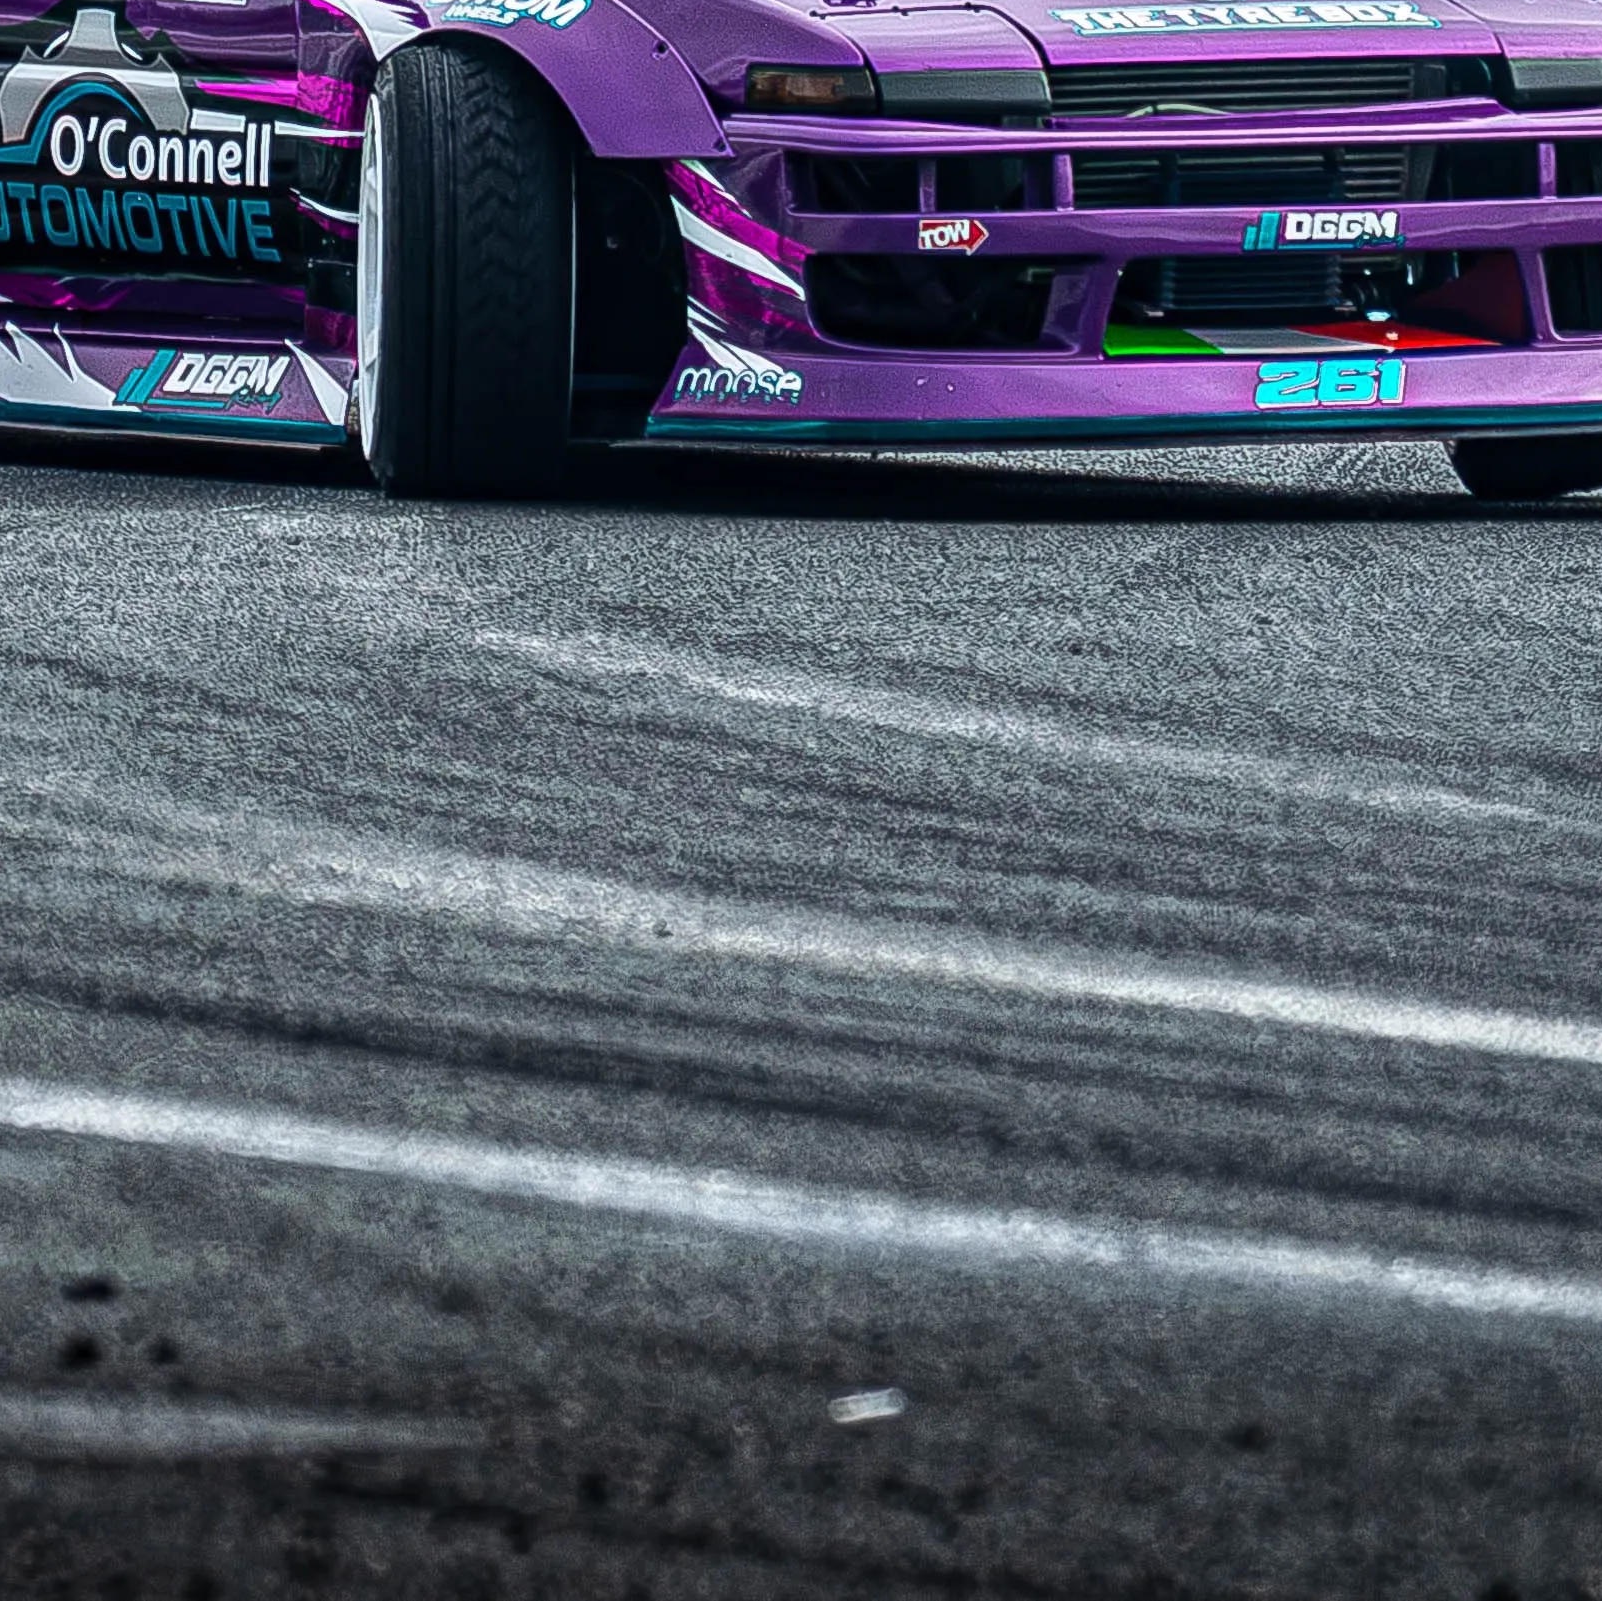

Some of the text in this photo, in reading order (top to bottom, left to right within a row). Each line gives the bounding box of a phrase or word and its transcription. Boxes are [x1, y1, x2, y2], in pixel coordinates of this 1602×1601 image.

[1062, 3, 1432, 30] THE TYRE BOX
[50, 114, 272, 188] O'Connell
[919, 219, 970, 250] TOW
[1285, 211, 1397, 240] DGGM
[163, 352, 290, 396] DGGM
[1255, 359, 1407, 409] 261
